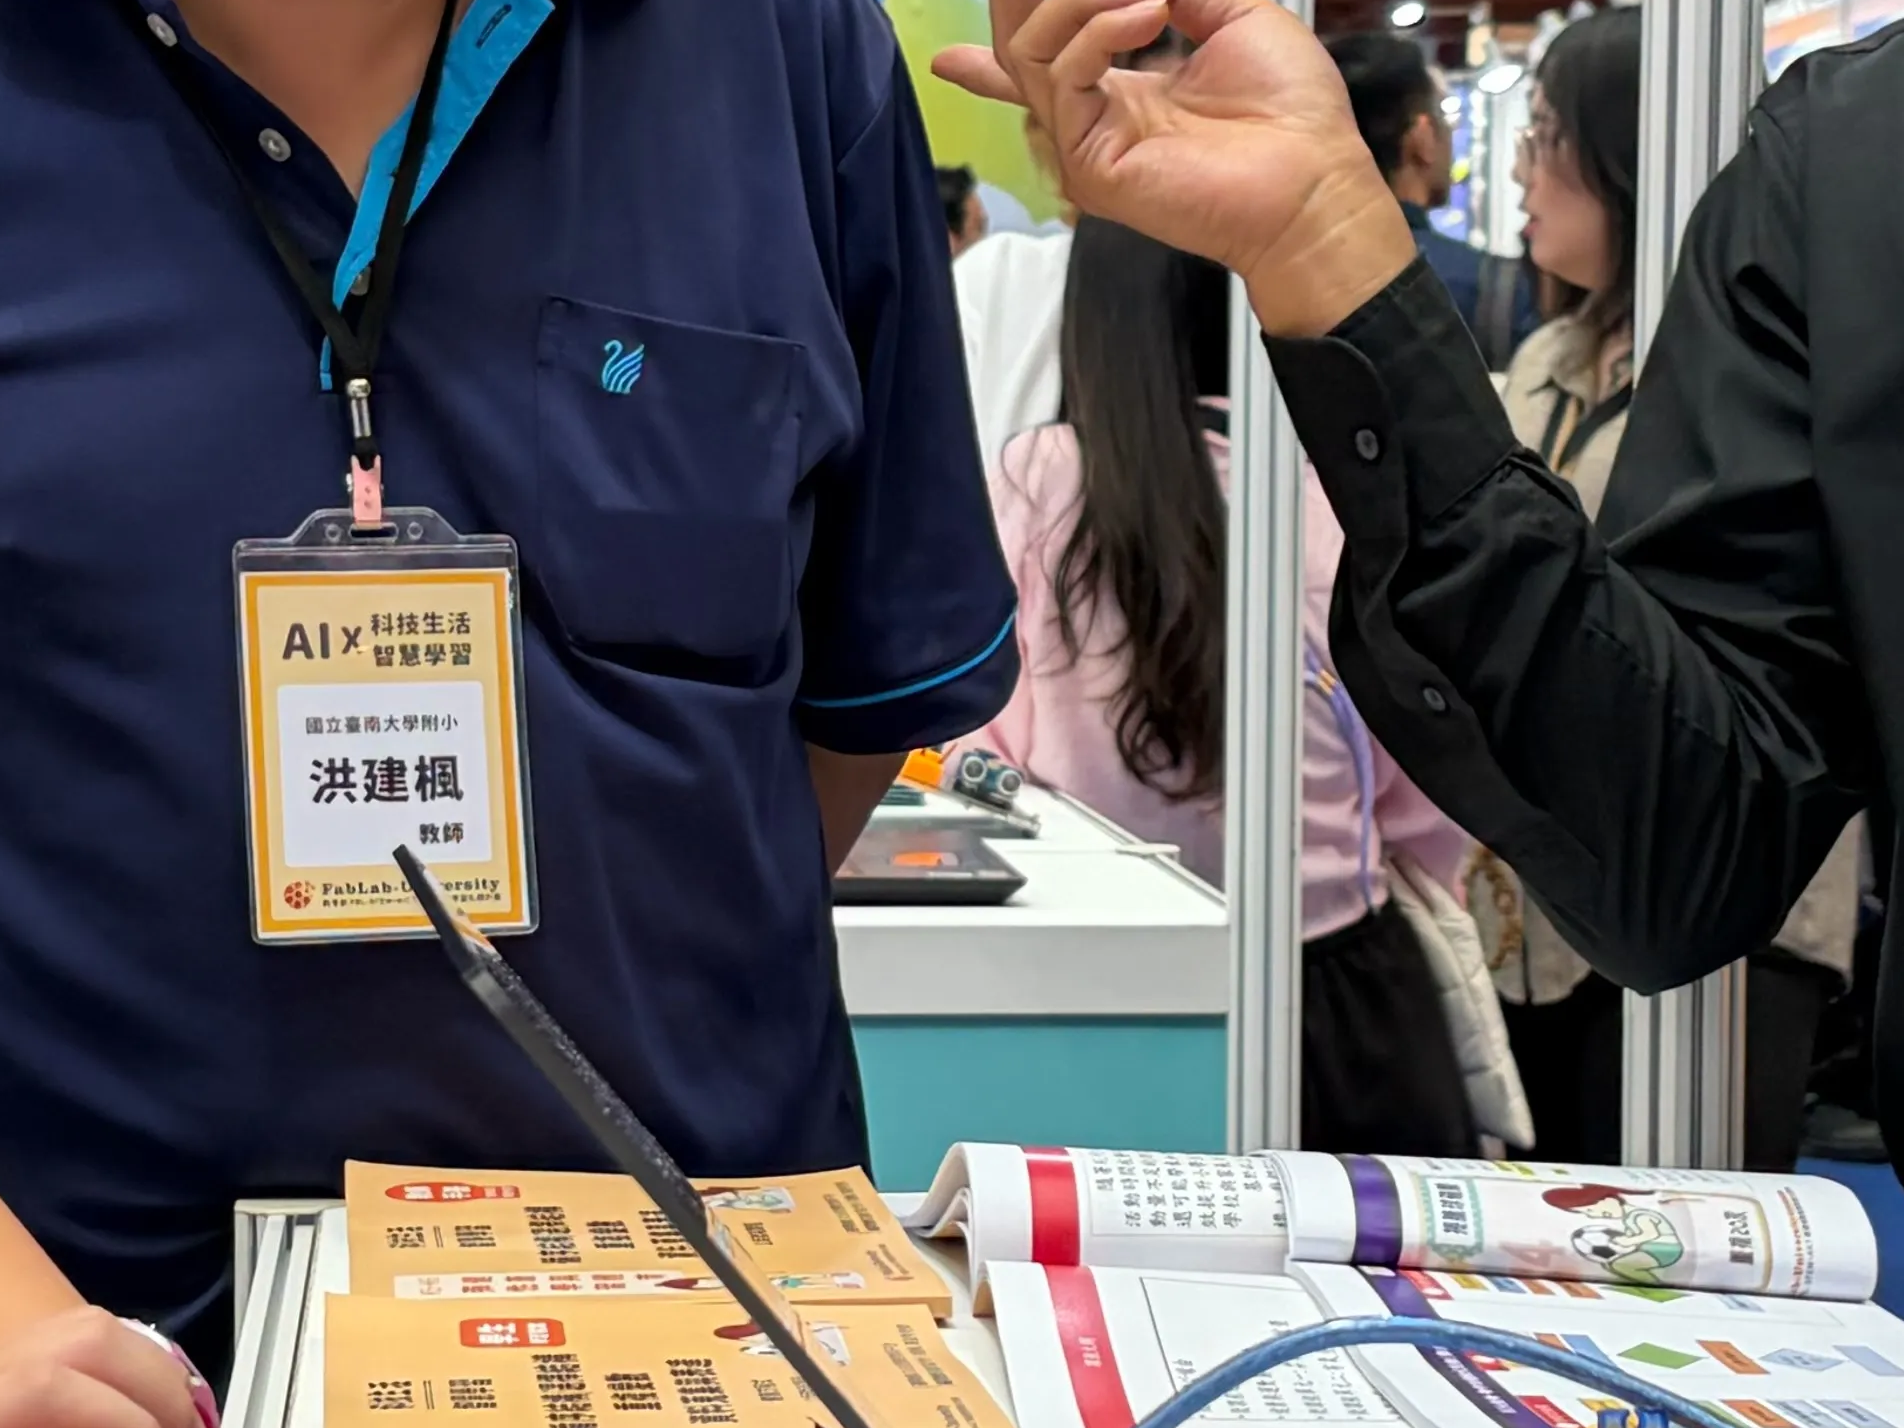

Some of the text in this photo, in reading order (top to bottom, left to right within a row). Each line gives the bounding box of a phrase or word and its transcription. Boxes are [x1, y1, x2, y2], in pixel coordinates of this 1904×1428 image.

[282, 621, 330, 661] AI
[370, 612, 471, 636] 科技生活
[373, 643, 472, 668] 智慧學習
[305, 714, 458, 735] 國立臺南大學附小
[309, 756, 464, 804] 洪建楓
[419, 822, 464, 844] 教師
[322, 878, 500, 896] FabLab-Uersity
